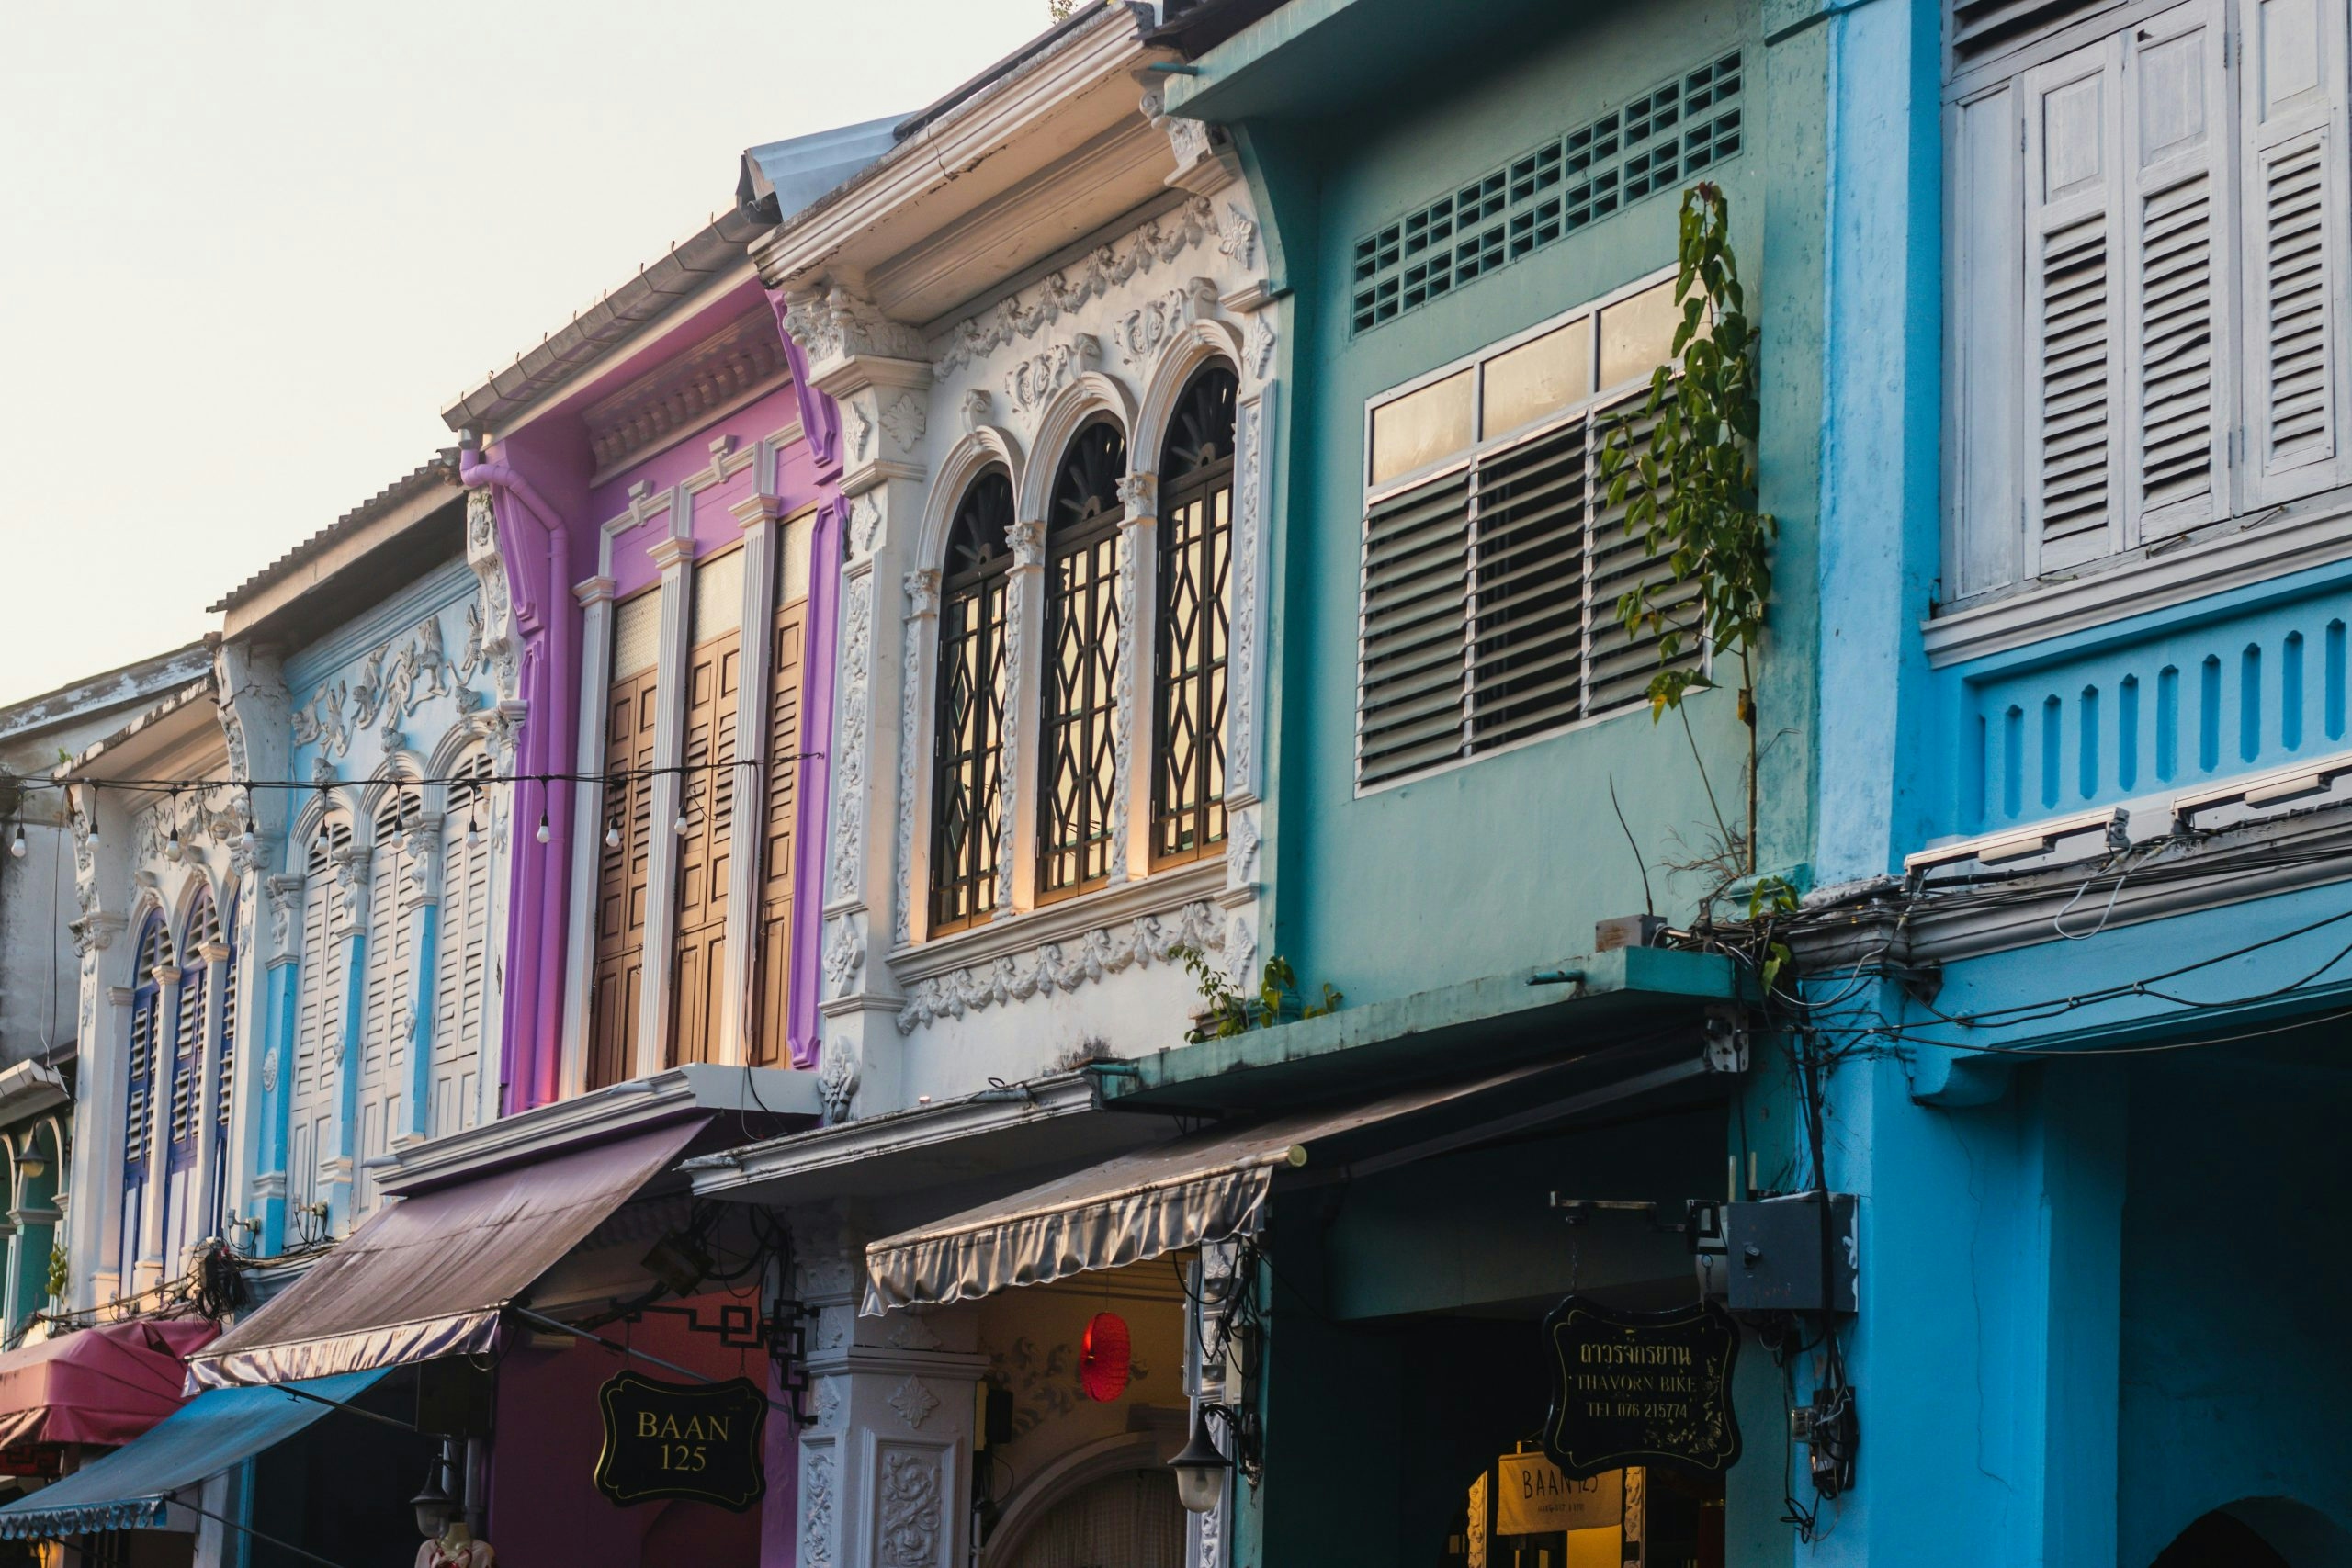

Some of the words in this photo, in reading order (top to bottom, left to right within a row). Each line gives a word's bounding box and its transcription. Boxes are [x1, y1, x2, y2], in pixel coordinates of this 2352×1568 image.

[1577, 1373, 1654, 1391] THAVORN
[1660, 1375, 1697, 1393] BIKE
[1645, 1403, 1687, 1418] 215774
[635, 1410, 731, 1442] BAAN
[661, 1443, 707, 1472] 125
[1522, 1469, 1572, 1499] BAAN
